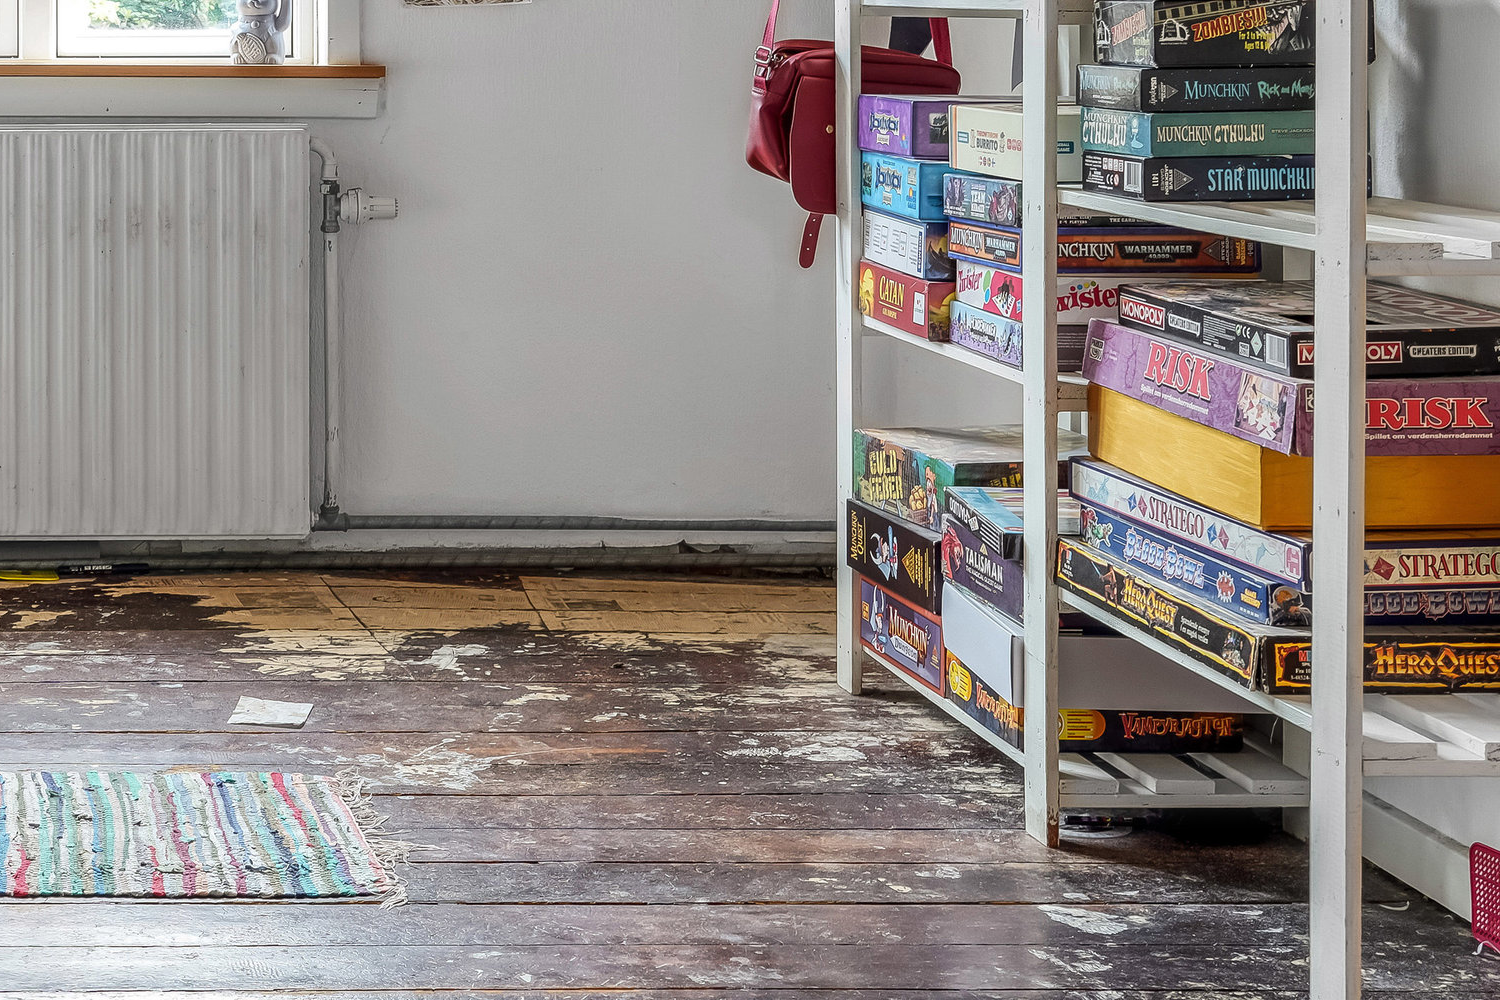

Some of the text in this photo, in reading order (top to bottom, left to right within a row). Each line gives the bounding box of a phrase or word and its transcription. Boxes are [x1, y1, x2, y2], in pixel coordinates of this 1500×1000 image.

[1083, 110, 1127, 123] MUNCHKIN
[976, 138, 998, 151] BURRITO
[1082, 121, 1127, 147] CTHULHU
[1157, 126, 1212, 145] MUNCHKIN
[1214, 124, 1265, 143] CTHULHU
[1208, 167, 1244, 191] STAR
[951, 226, 983, 254] MUNCHKIN
[1058, 242, 1193, 260] NCHKIN WARHAMMER
[879, 275, 905, 308] CATAN
[958, 269, 983, 294] Twister
[1057, 283, 1119, 312] wister
[1122, 299, 1164, 328] MONOPOLY
[1412, 346, 1475, 356] CHEATERS EDITION
[1144, 341, 1216, 401] RISK
[1364, 397, 1493, 430] RISK
[869, 450, 897, 474] GULD
[870, 475, 904, 500] FEBER
[1148, 497, 1205, 539] STRATEGO
[850, 510, 858, 560] MUNCHKIN
[965, 547, 1004, 585] TALISMAN
[1163, 545, 1205, 588] BOWL
[888, 605, 928, 654] MUNCHKIN
[894, 638, 918, 662] Dungeon
[1374, 646, 1500, 680] HEROQUES
